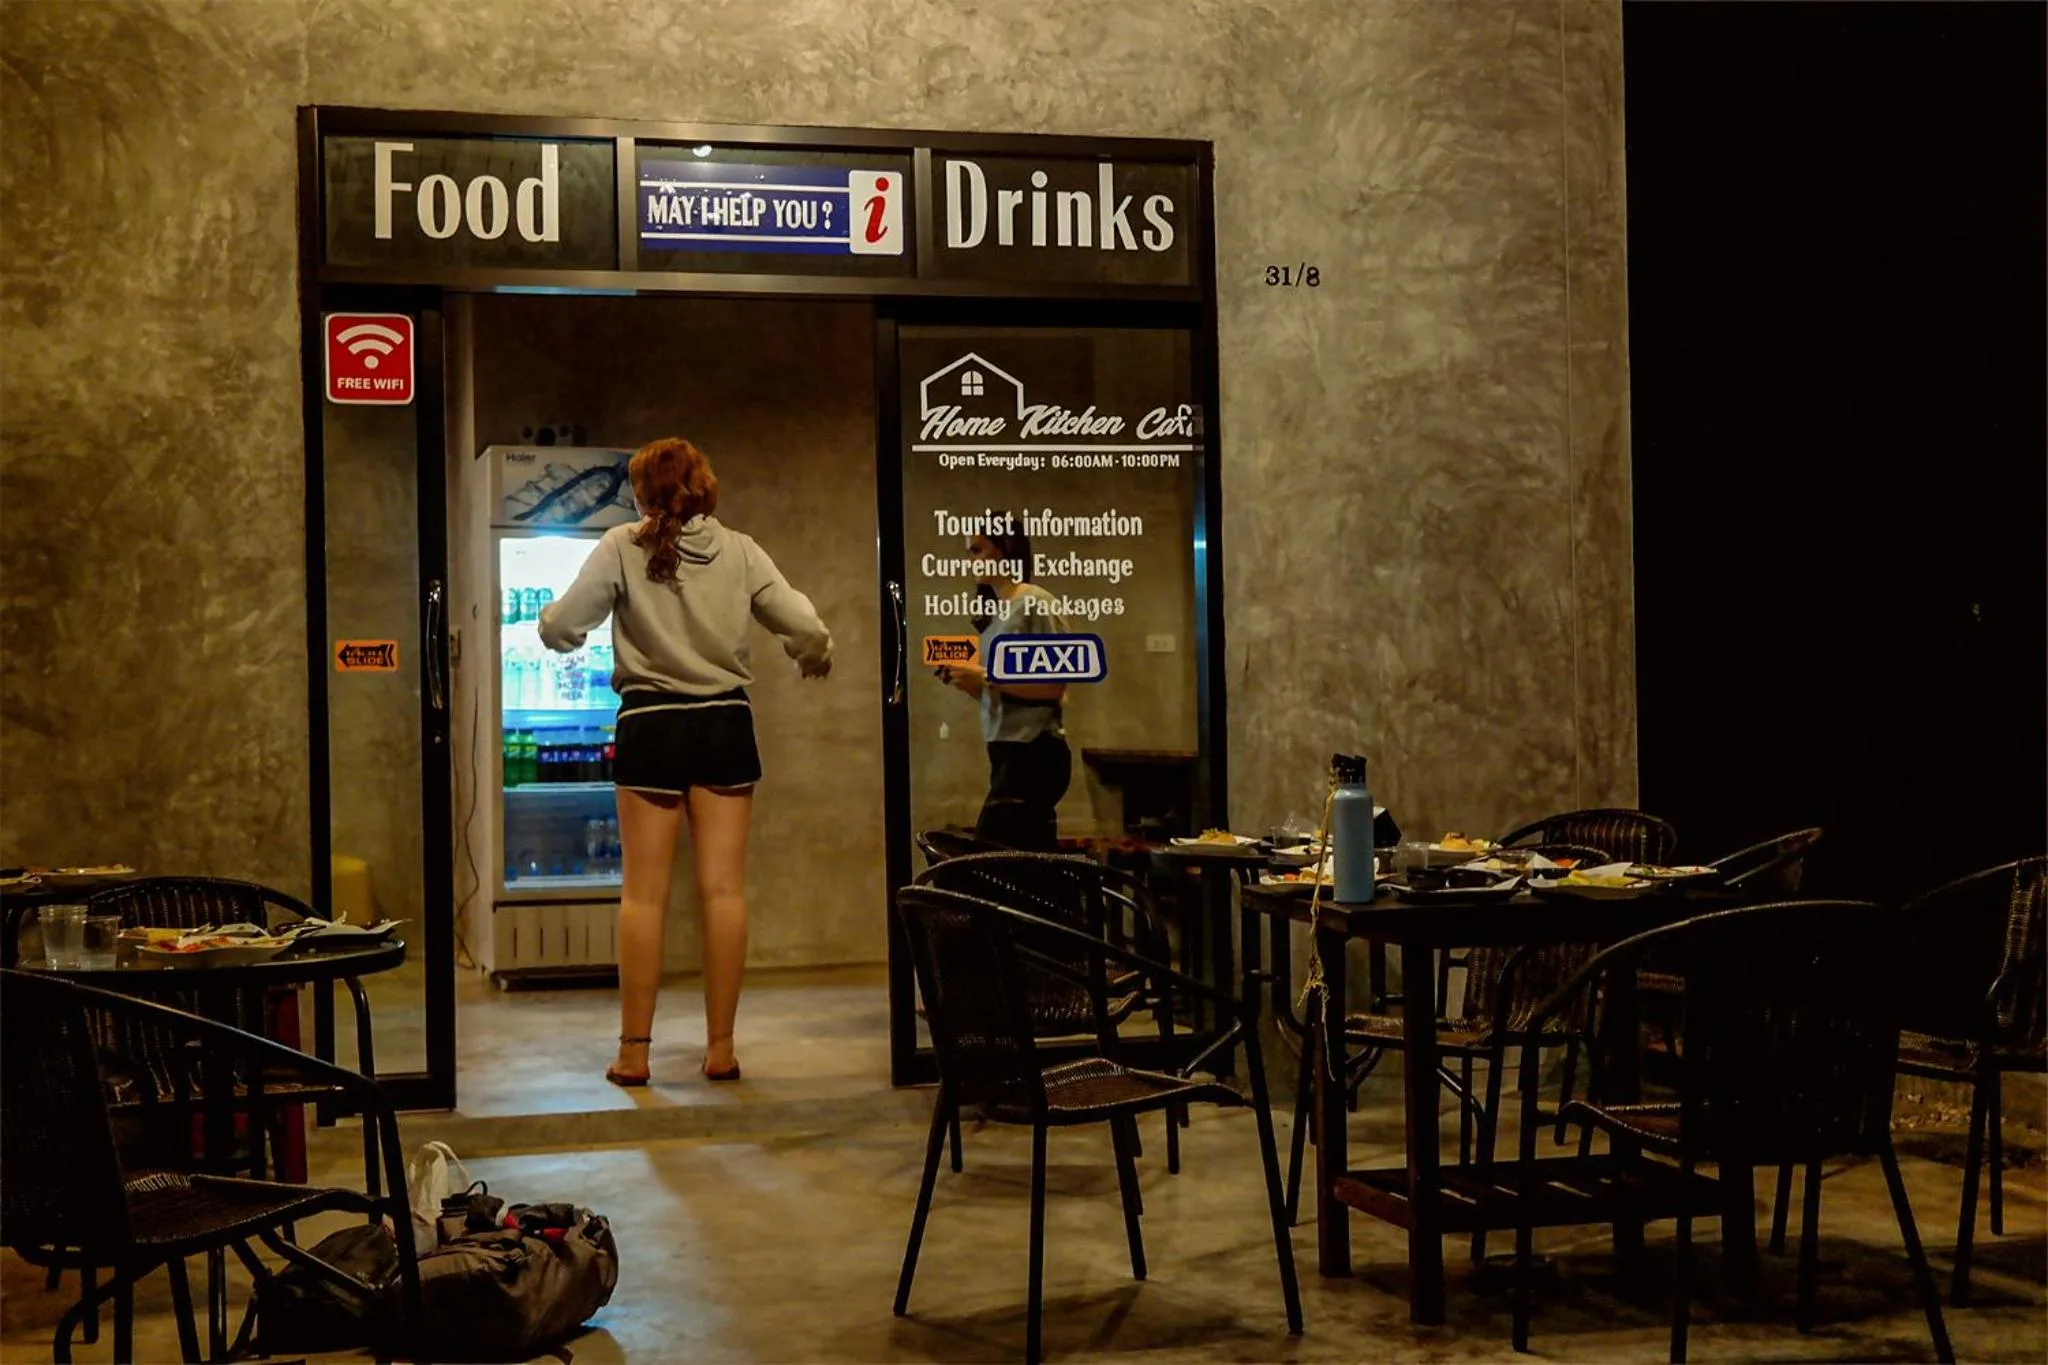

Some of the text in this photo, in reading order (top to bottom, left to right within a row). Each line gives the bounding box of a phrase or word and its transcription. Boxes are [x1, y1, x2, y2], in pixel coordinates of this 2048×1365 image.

[374, 141, 560, 242] Food
[945, 160, 1174, 252] Drinks
[648, 195, 694, 225] MAY
[713, 198, 767, 227] HELP
[1265, 264, 1321, 287] 31/8
[337, 377, 404, 390] FREE WIFI
[920, 405, 1007, 440] Home
[1019, 405, 1126, 439] Kitchen
[938, 453, 975, 470] Open
[934, 509, 1143, 537] Tourist information
[921, 552, 1134, 583] Currency Exchange
[924, 592, 1125, 621] Holiday Packages
[1009, 645, 1085, 673] TAXI
